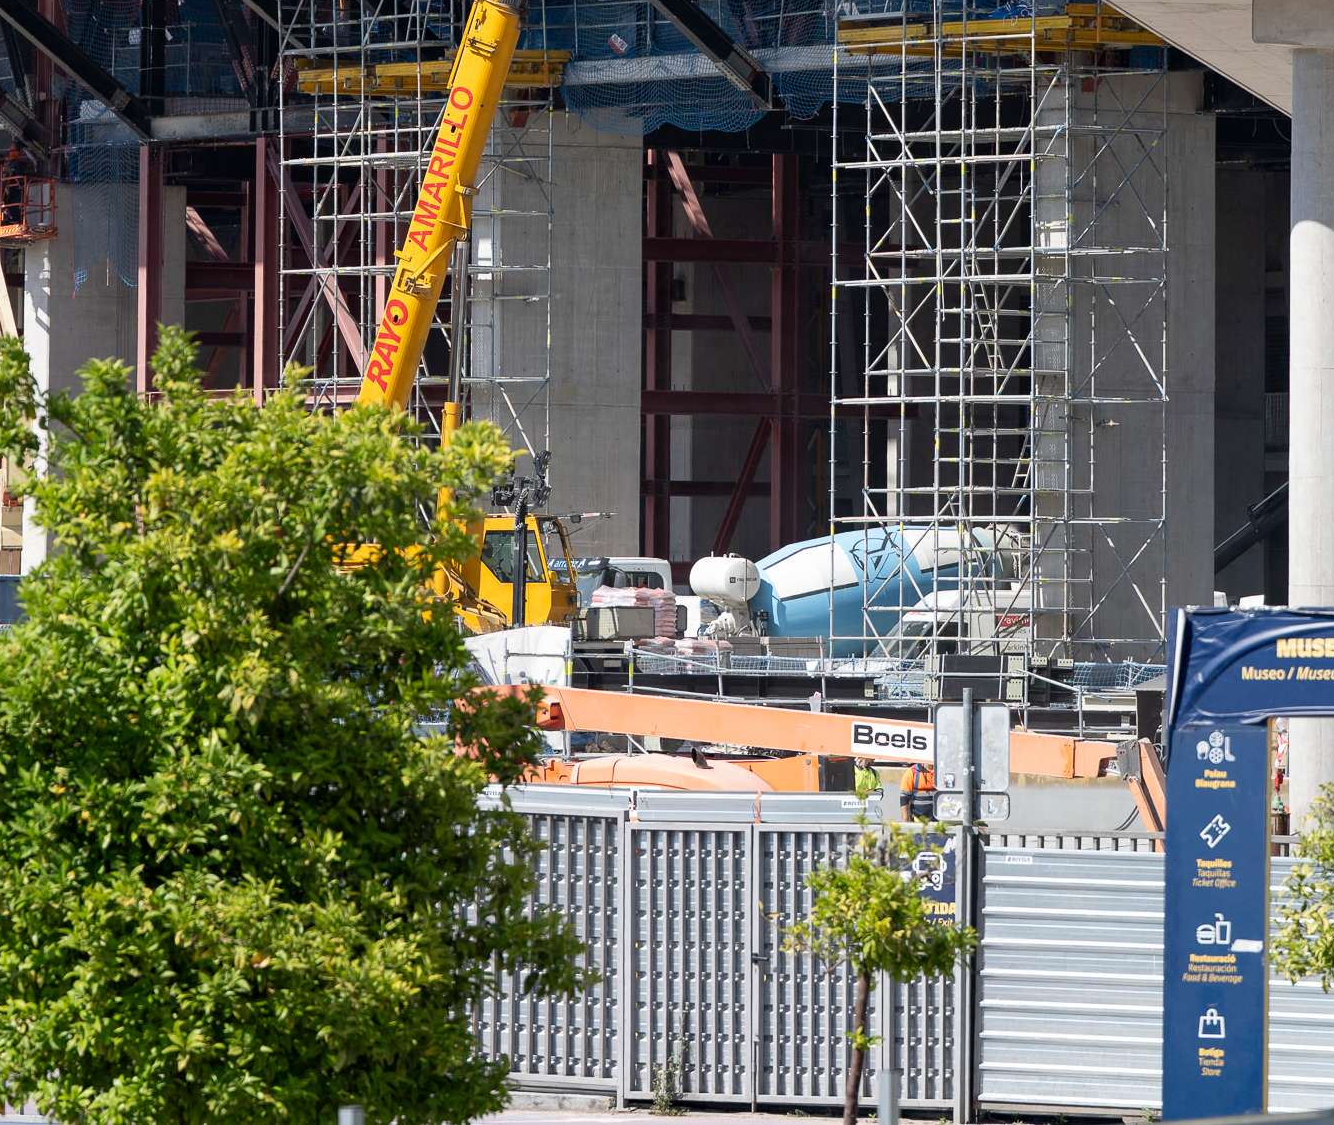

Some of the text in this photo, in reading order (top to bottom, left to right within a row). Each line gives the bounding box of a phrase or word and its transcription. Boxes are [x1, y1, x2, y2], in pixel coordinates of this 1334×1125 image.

[367, 86, 475, 394] RAYO AMARILLO
[1241, 666, 1286, 681] Museo
[1286, 666, 1295, 681] /
[853, 723, 928, 751] Boels
